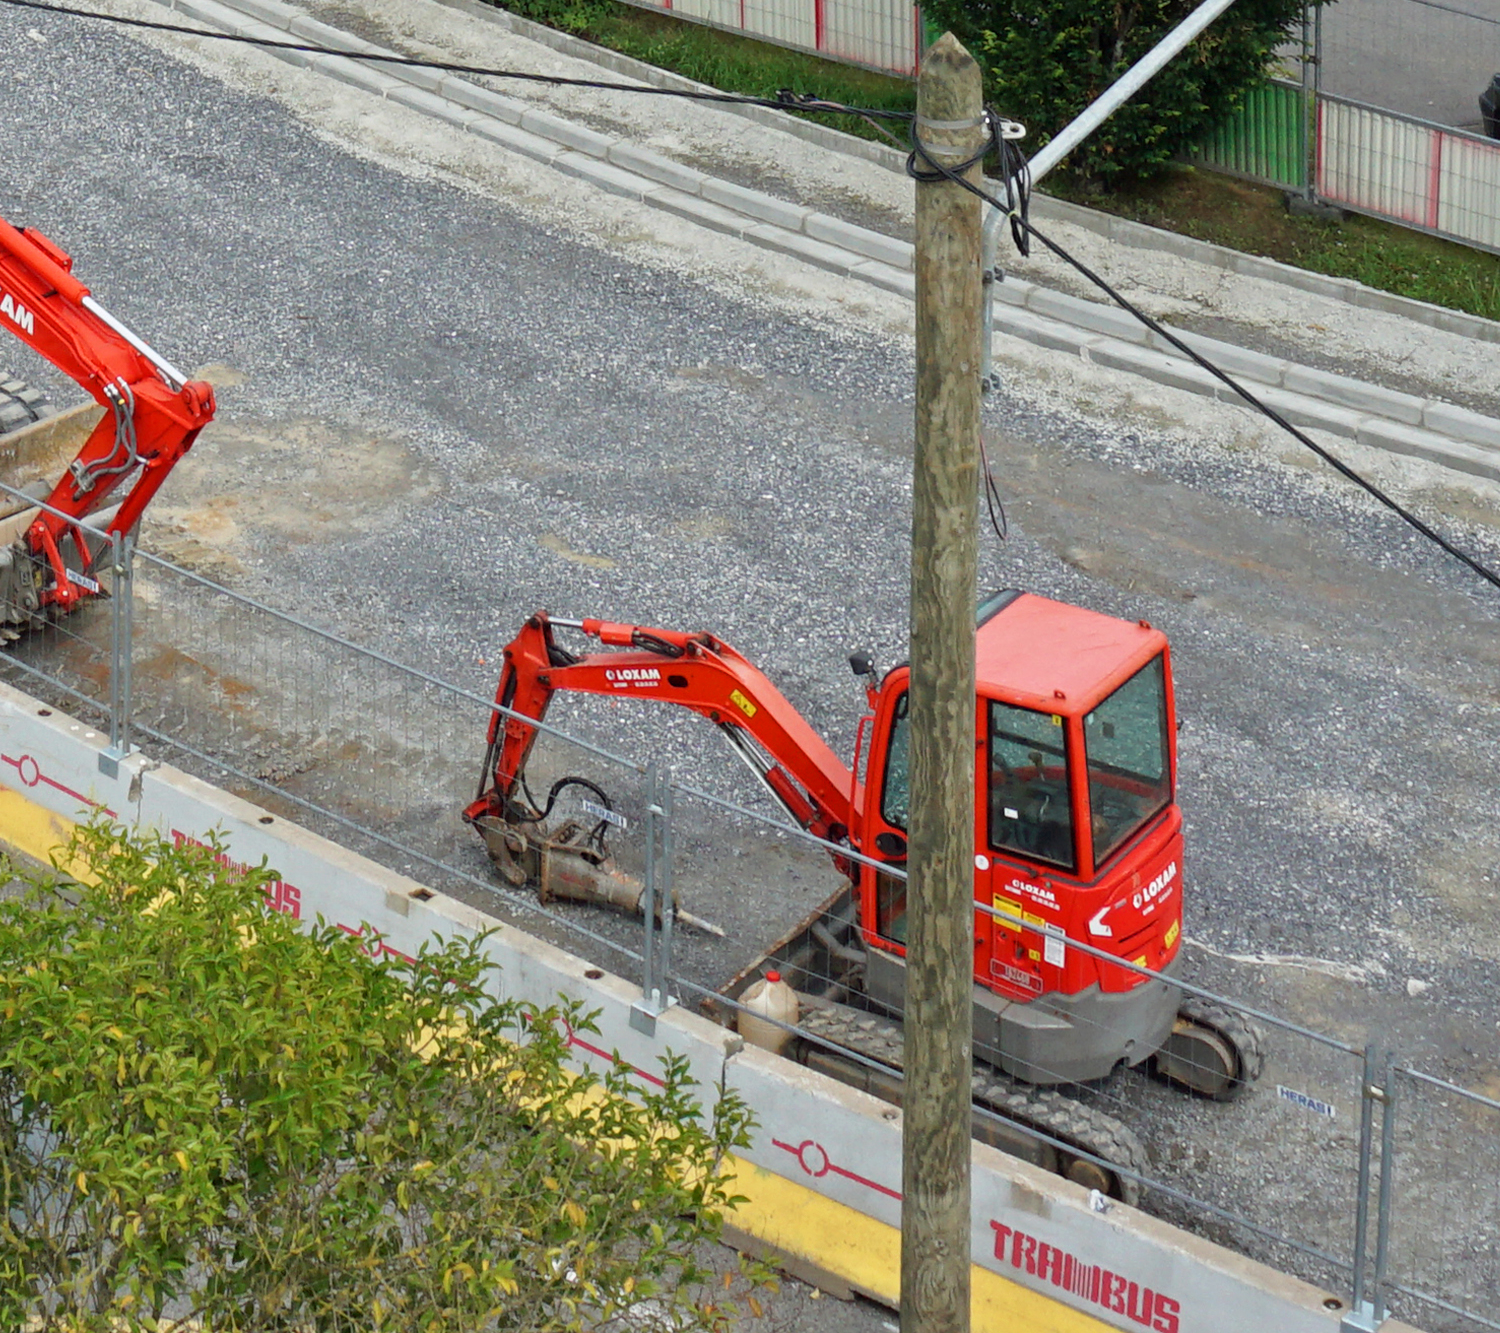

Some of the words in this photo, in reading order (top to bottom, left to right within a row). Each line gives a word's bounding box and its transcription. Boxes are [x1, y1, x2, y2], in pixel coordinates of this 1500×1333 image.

[615, 668, 661, 680] LOXAM
[1020, 882, 1055, 902] LOXAM
[1142, 861, 1177, 902] LOXAM
[1280, 1087, 1325, 1113] HERAS
